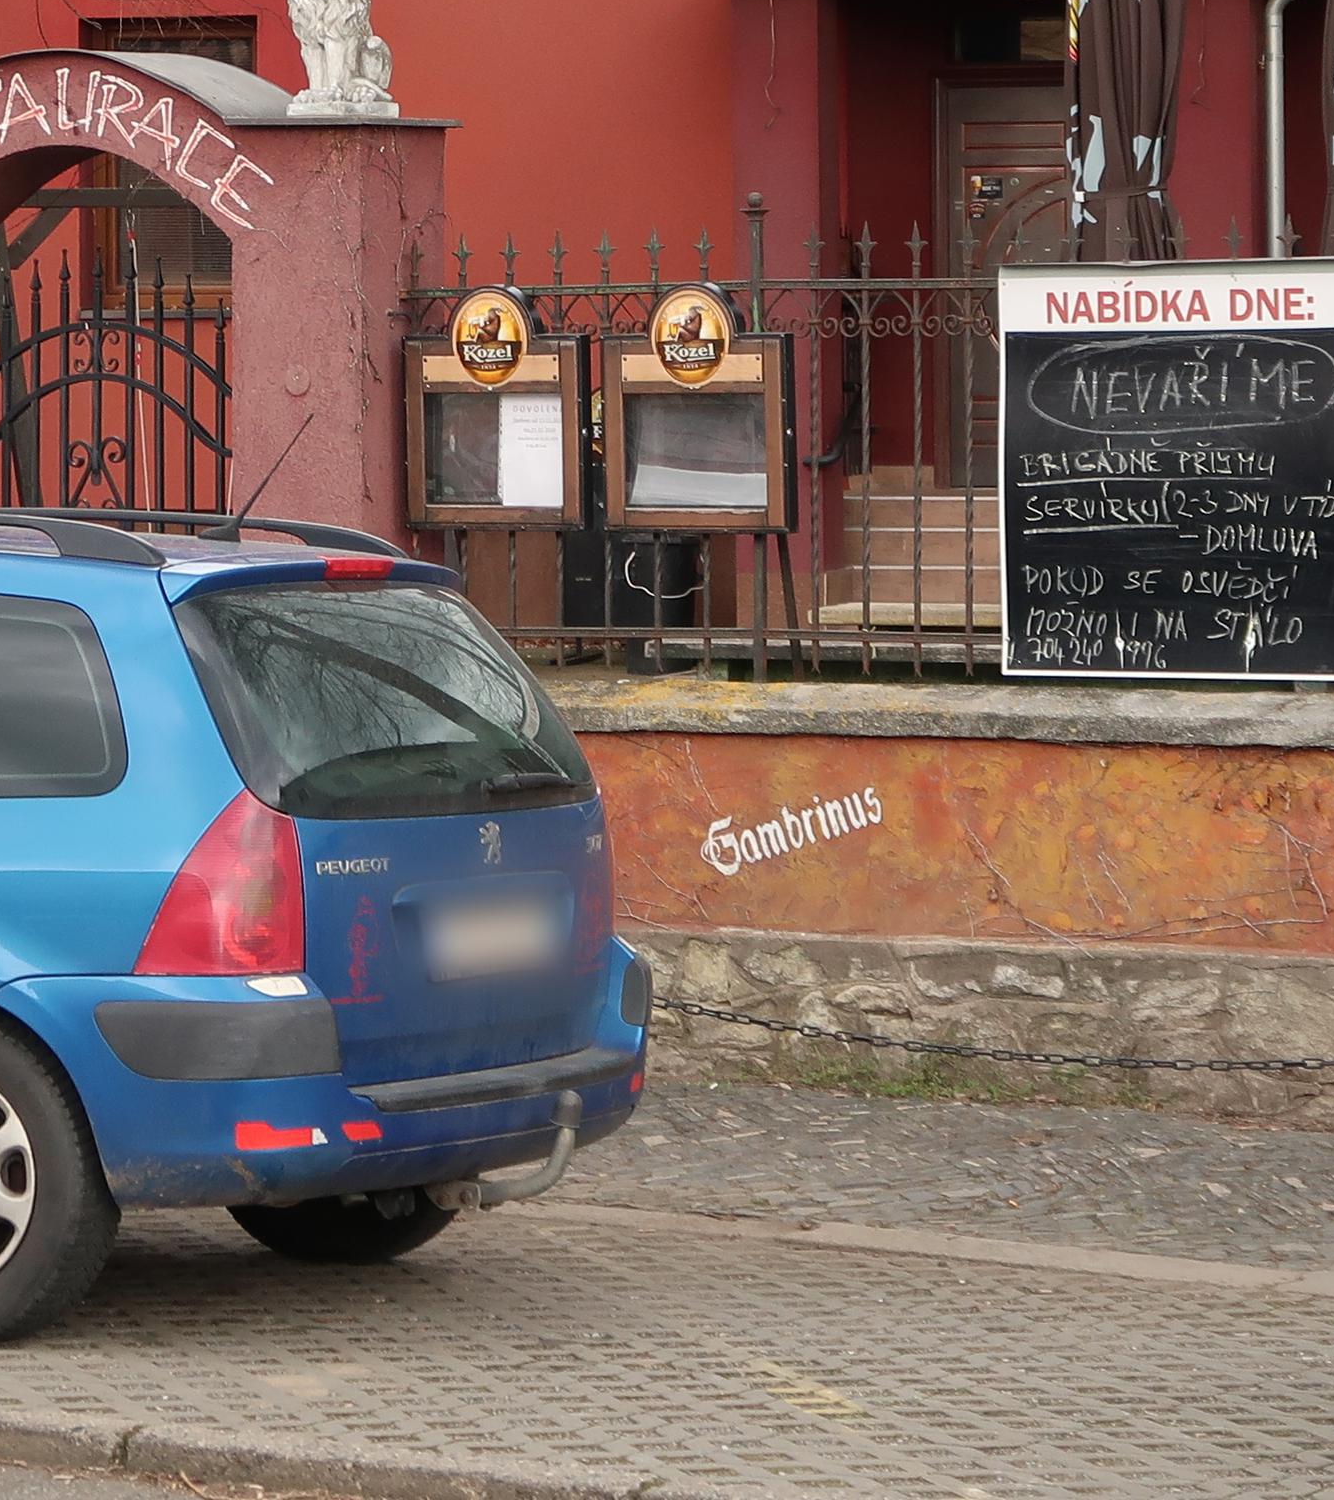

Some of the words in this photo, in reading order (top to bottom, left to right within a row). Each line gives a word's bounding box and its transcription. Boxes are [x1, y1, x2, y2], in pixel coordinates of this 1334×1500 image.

[1046, 280, 1211, 324] NABÍDKA
[1229, 288, 1315, 321] DNE:
[463, 345, 513, 363] Kozel
[663, 343, 716, 363] Kozel
[1071, 342, 1315, 419] NEVAŘÍME
[1226, 491, 1270, 516] DNY
[1201, 525, 1319, 560] DOMLUVA
[1023, 564, 1105, 597] POKUD
[1124, 568, 1163, 594] SE
[1154, 608, 1188, 642] NA
[701, 787, 882, 877] Gambrinus
[315, 857, 390, 876] PEUGEOT
